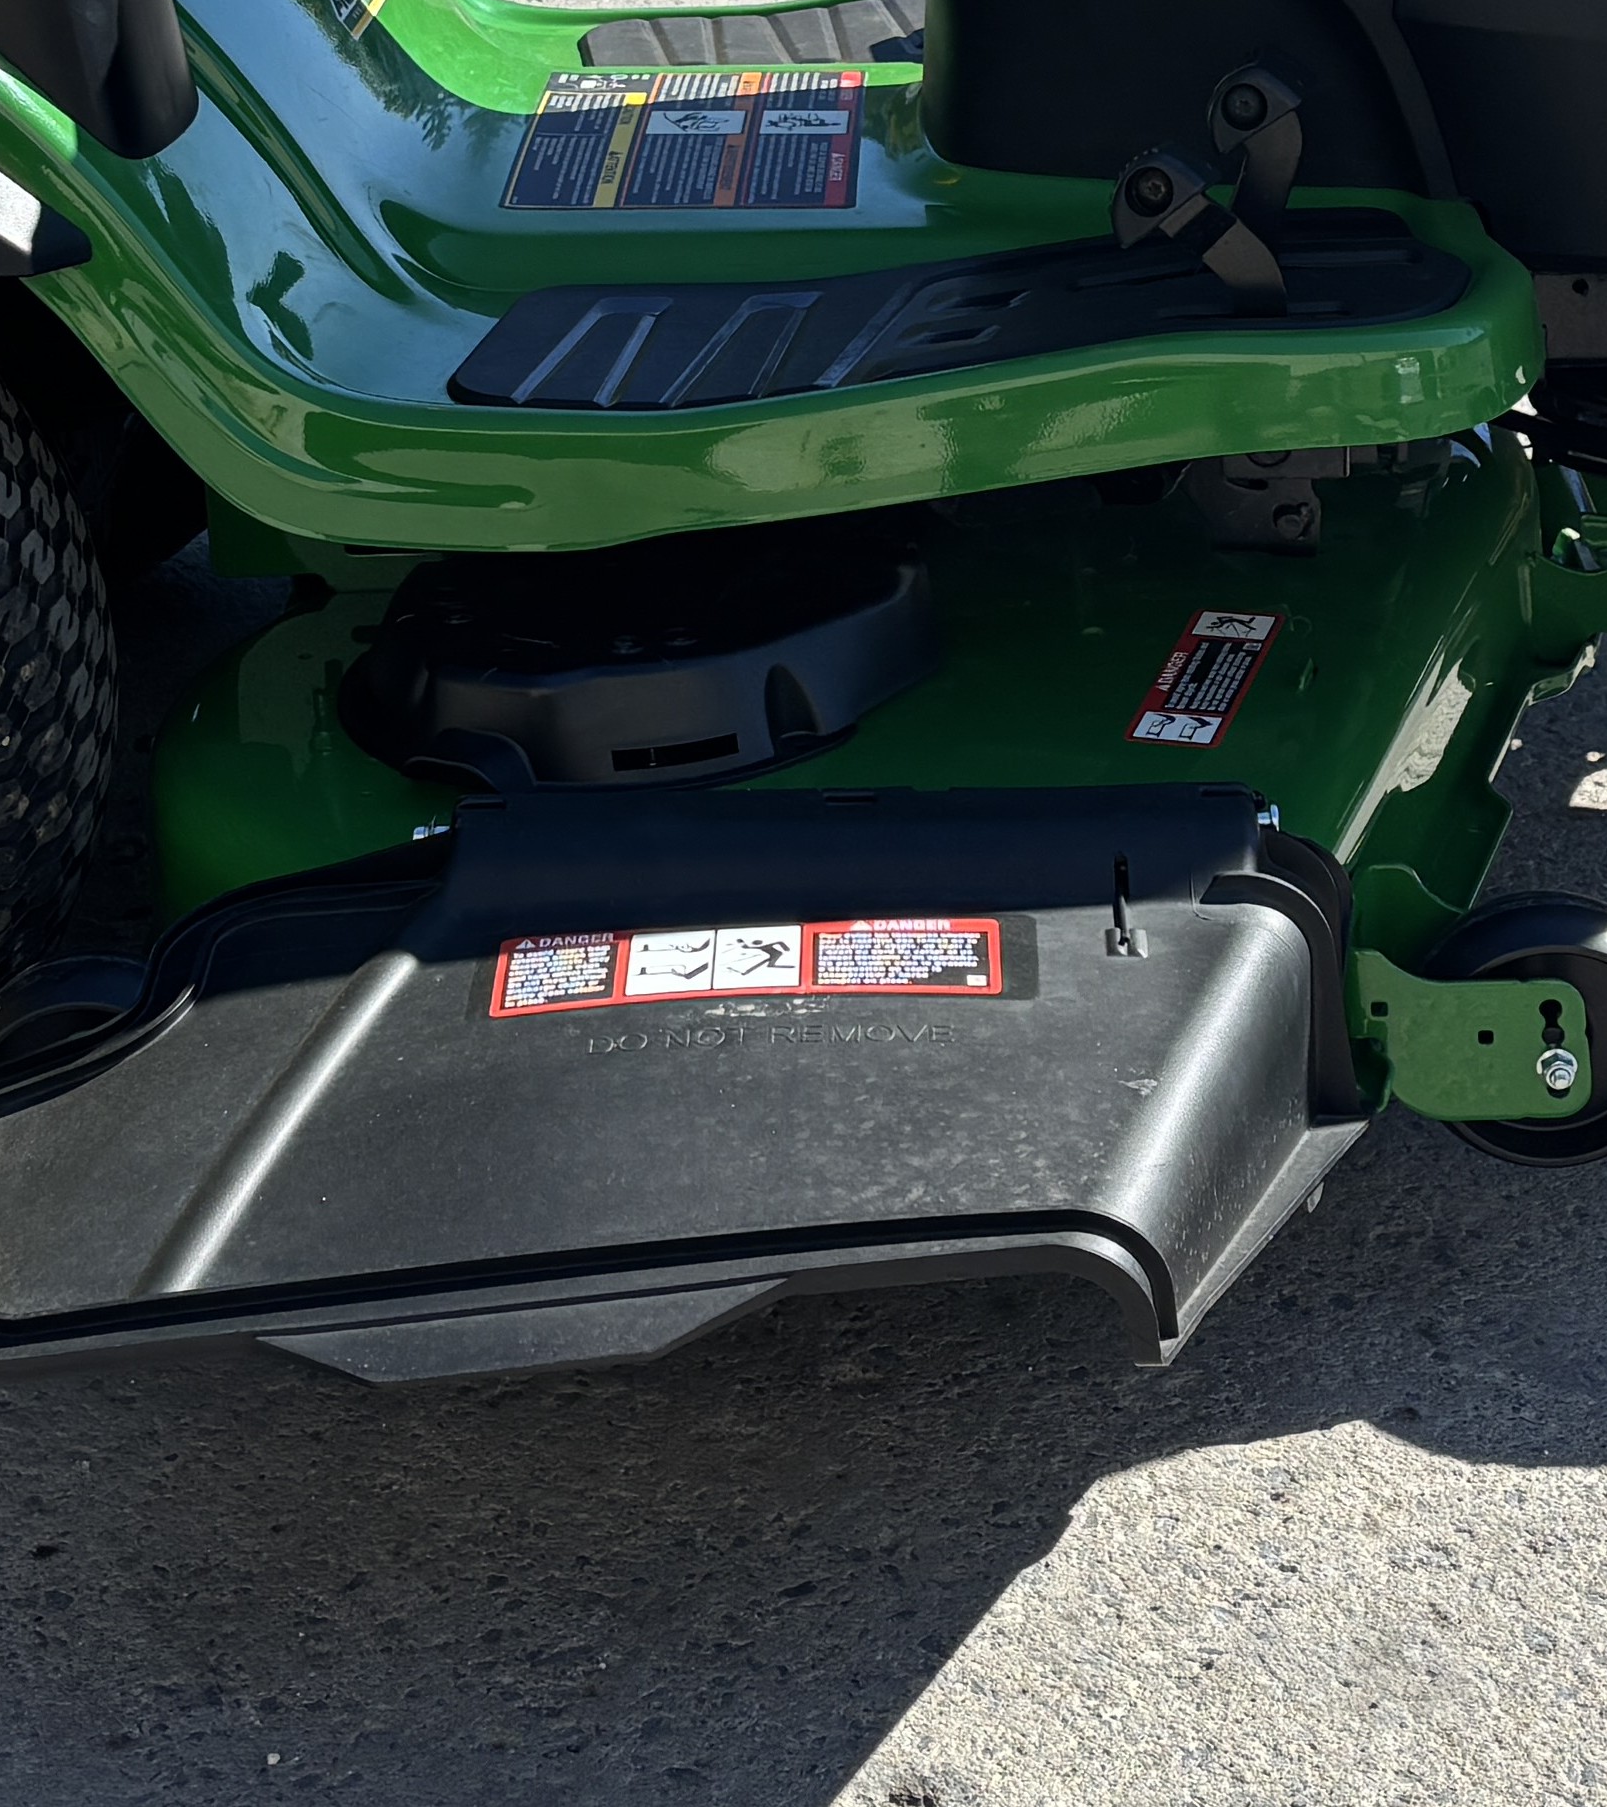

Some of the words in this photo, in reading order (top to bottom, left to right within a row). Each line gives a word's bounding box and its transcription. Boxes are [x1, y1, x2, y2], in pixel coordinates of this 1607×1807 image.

[873, 919, 951, 931] DANGER
[539, 932, 614, 948] DANGER
[588, 1033, 648, 1054] DO
[665, 1026, 754, 1050] NOT
[770, 1023, 956, 1045] REMOVE
